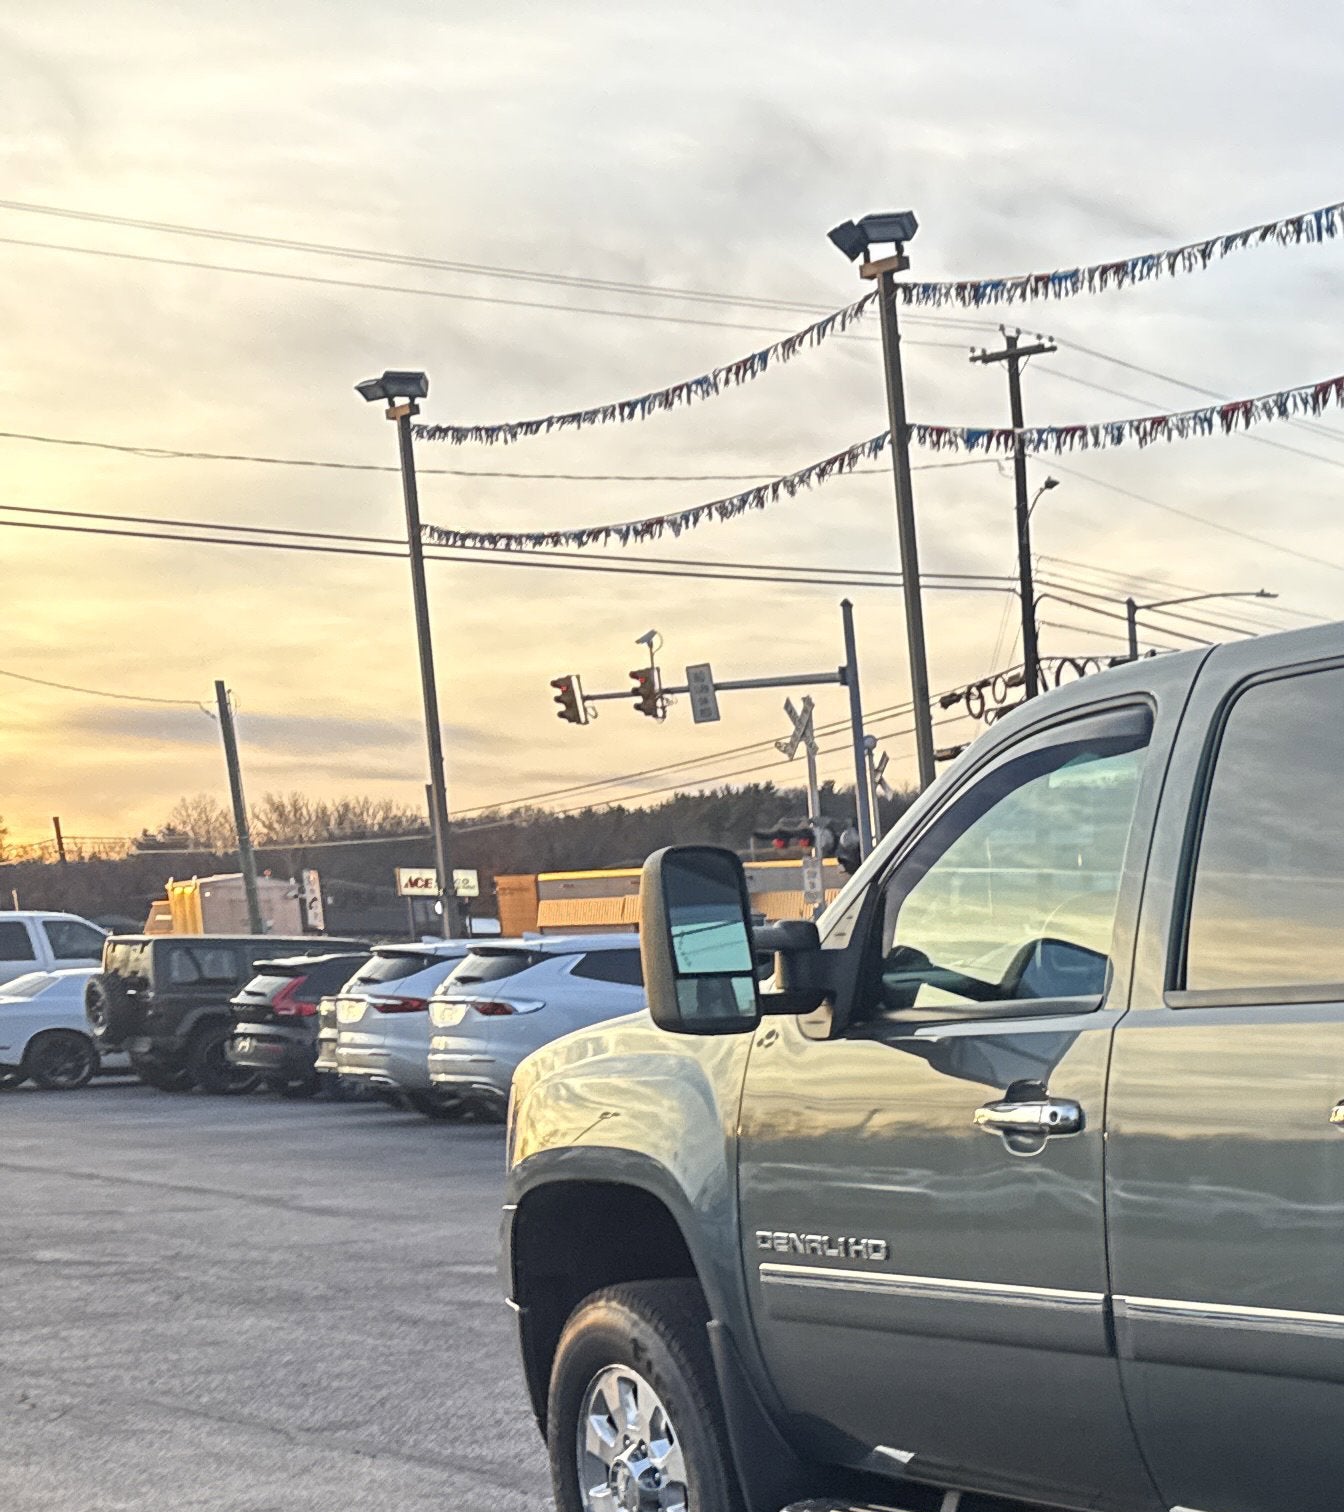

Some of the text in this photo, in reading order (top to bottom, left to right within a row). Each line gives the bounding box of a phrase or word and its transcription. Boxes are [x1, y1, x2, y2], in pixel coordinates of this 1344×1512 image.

[404, 876, 433, 889] ACE
[755, 1230, 888, 1261] DENALI HD
